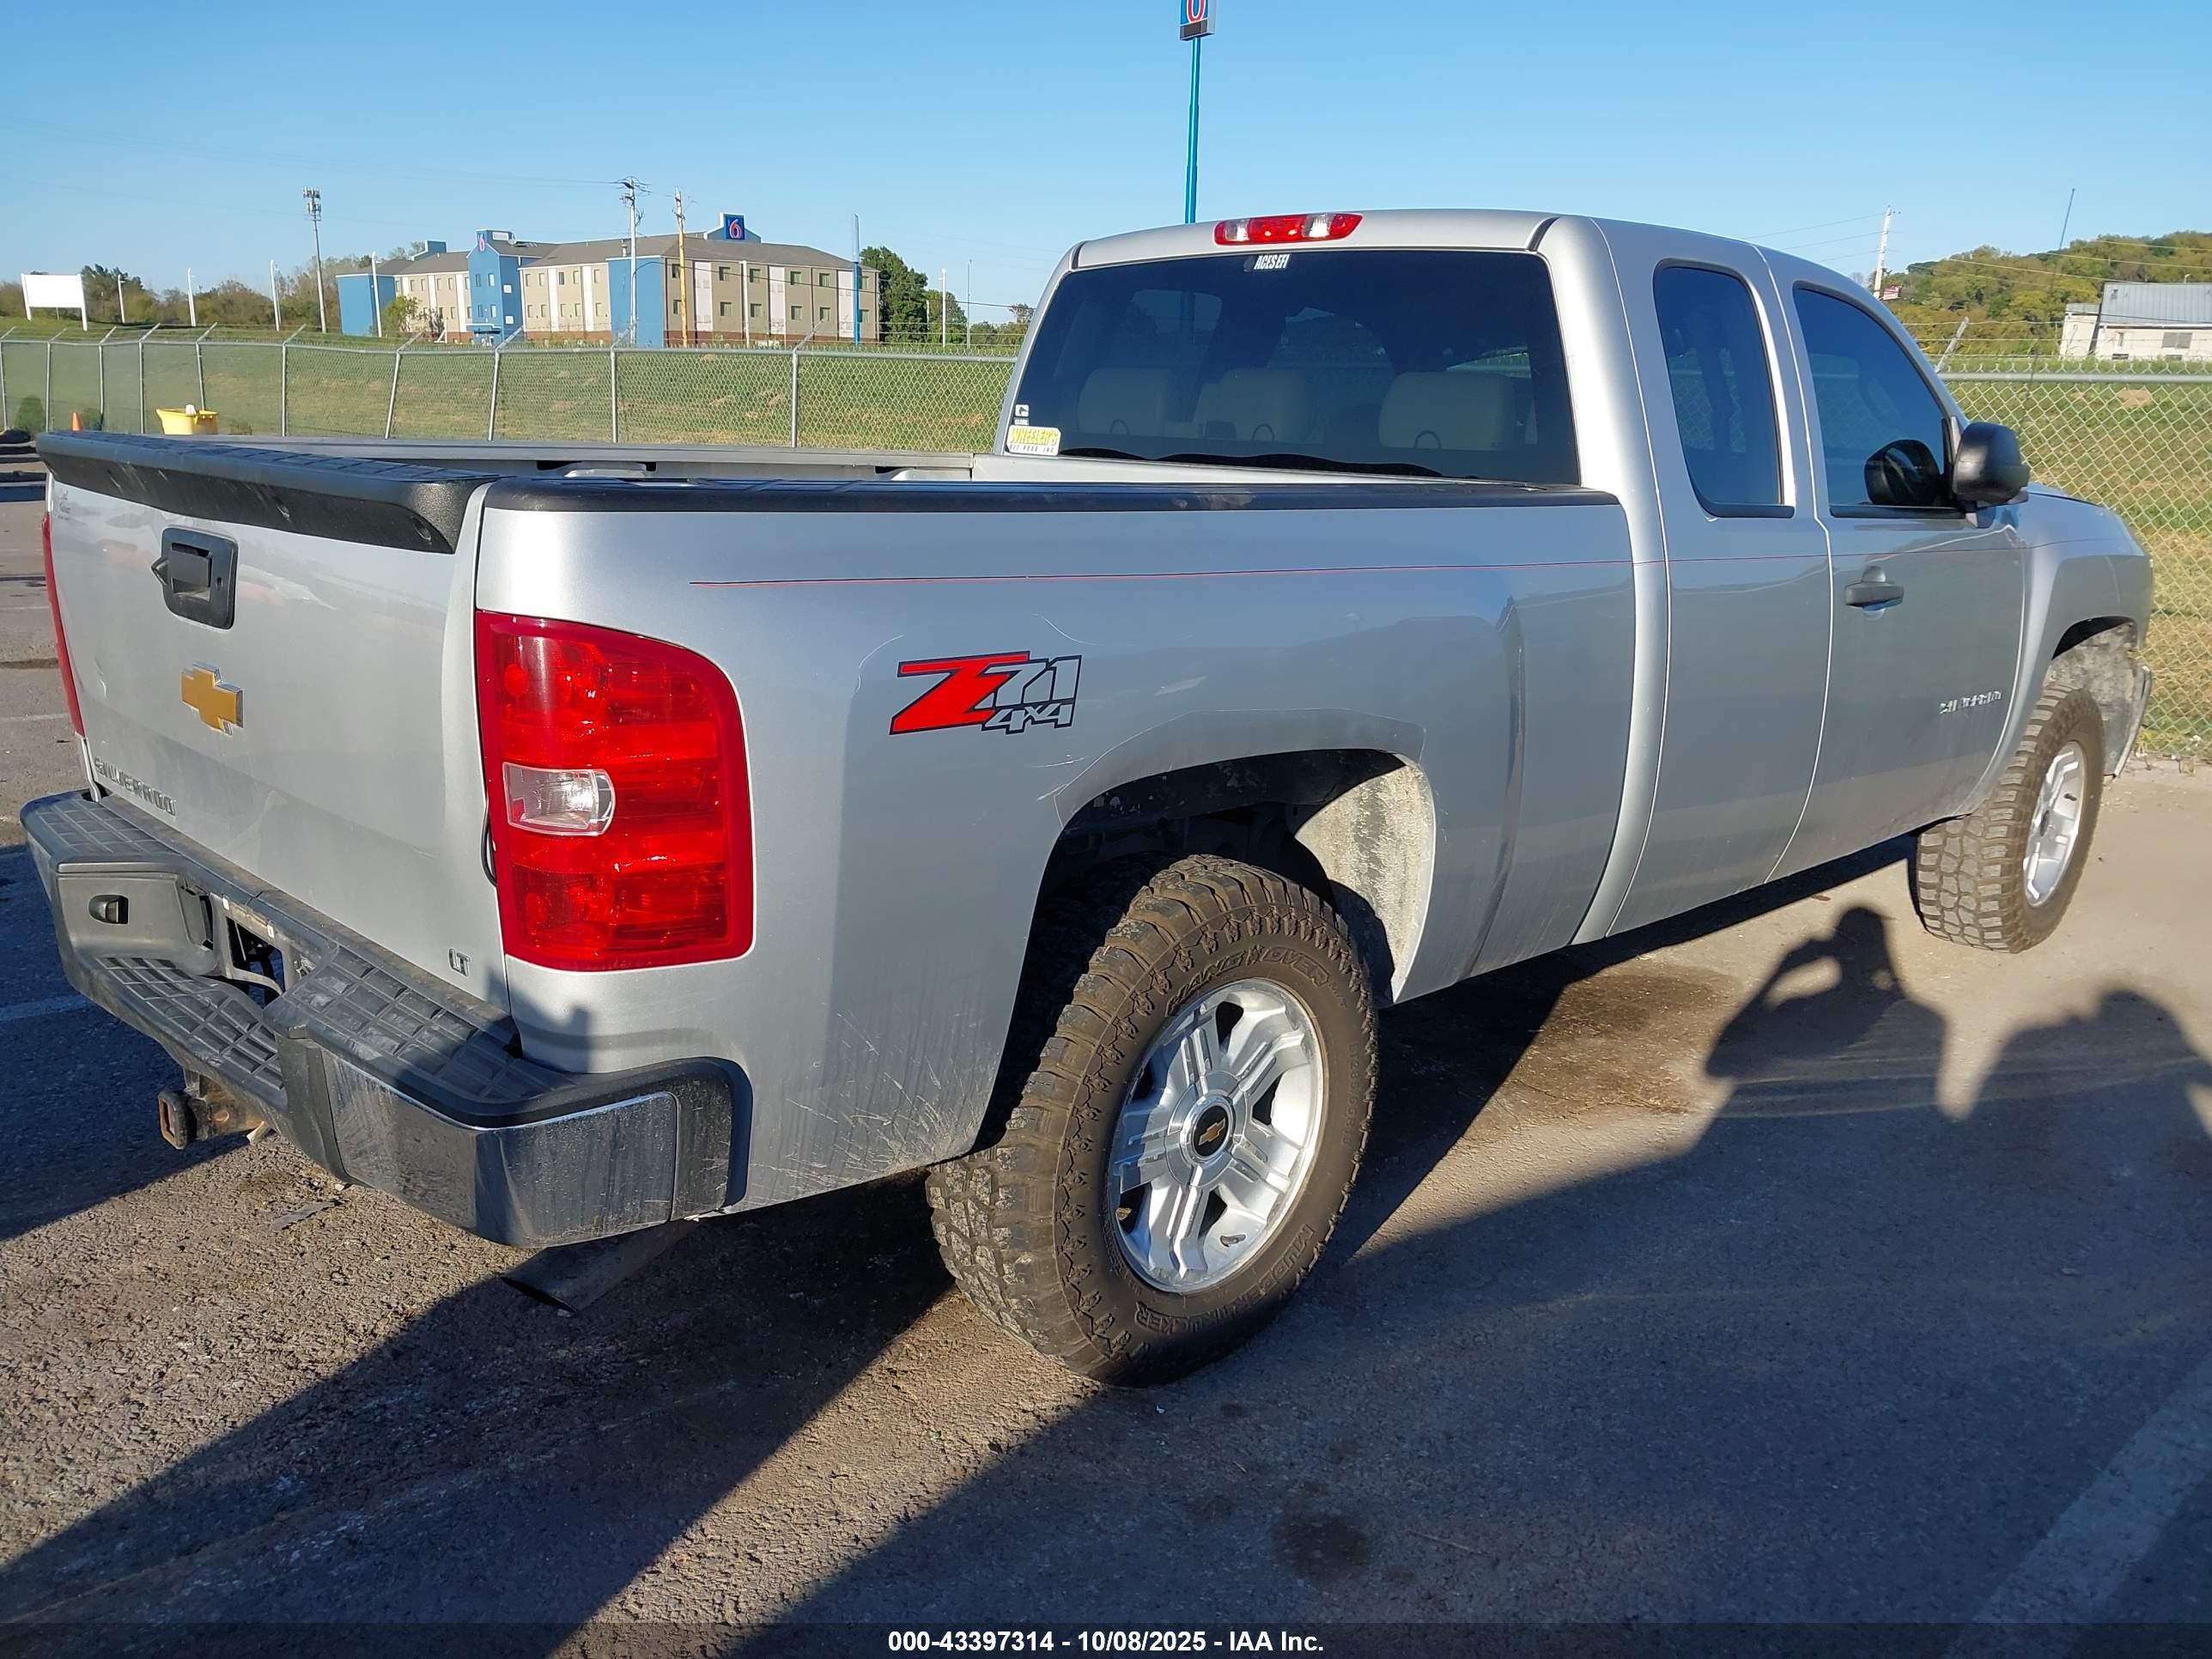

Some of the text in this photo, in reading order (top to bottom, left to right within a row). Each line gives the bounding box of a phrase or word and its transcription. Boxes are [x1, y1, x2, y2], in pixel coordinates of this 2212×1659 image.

[729, 218, 743, 240] 6
[94, 757, 177, 817] SILVERADO
[448, 948, 471, 977] LT
